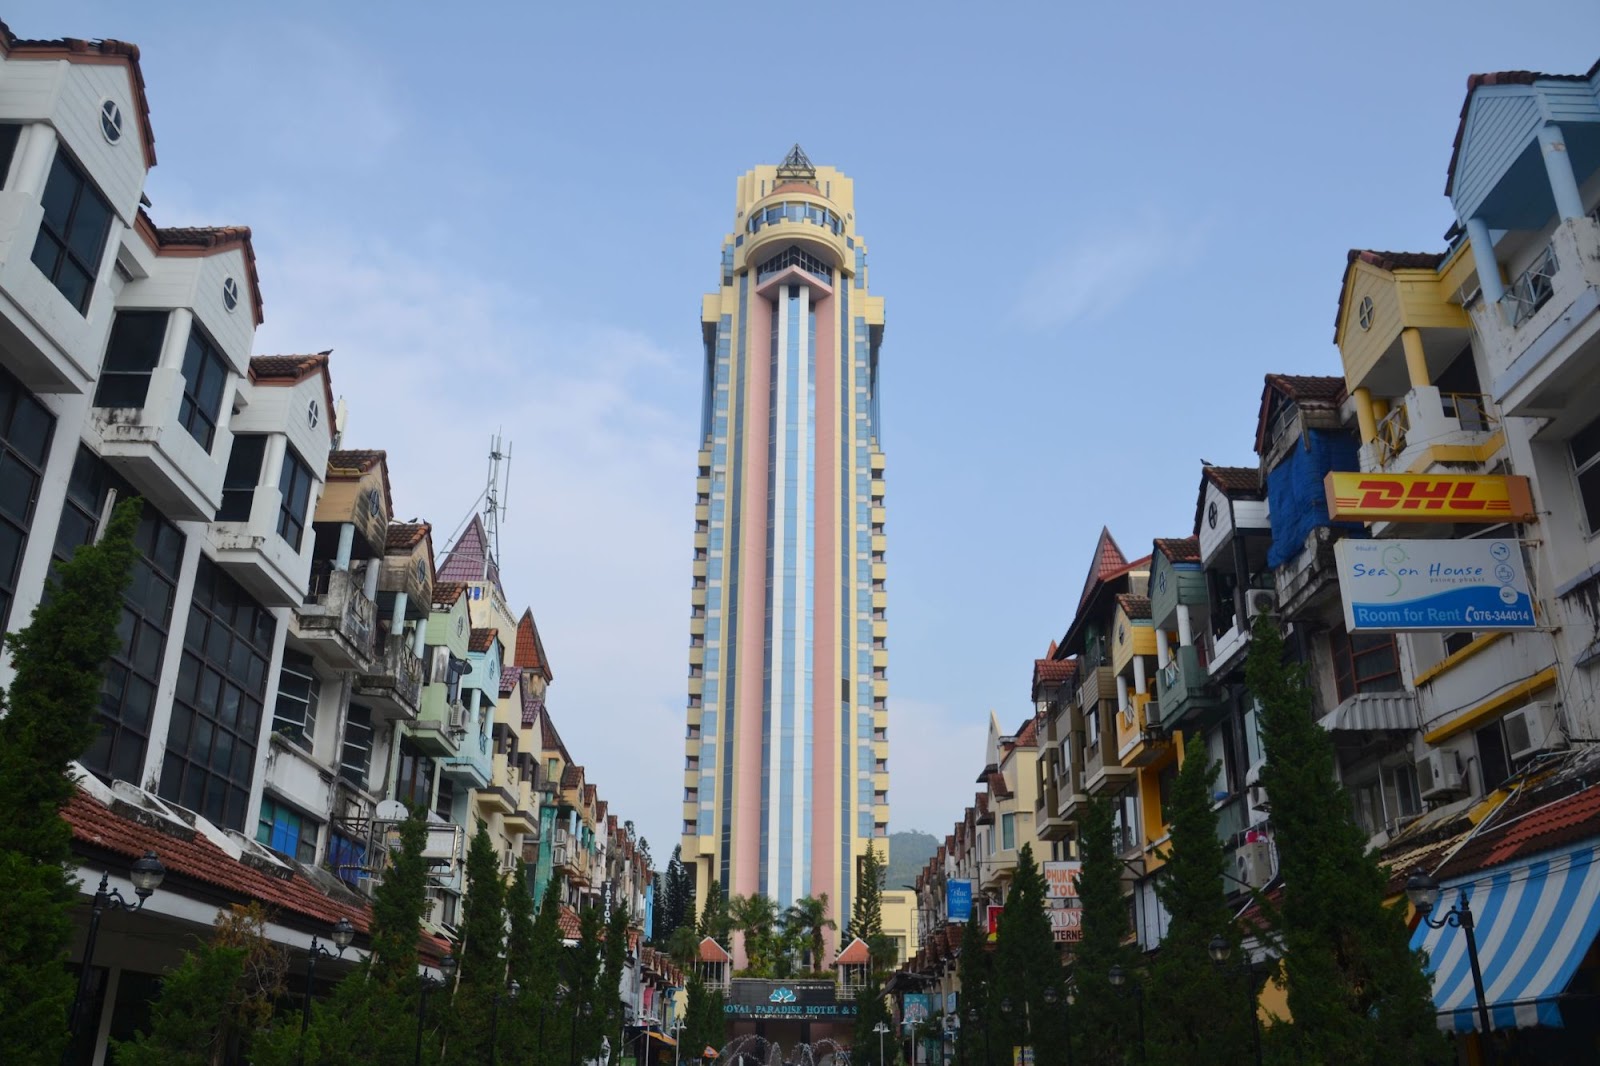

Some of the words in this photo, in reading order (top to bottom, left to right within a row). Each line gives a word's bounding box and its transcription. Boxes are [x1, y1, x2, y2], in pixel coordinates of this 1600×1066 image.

[1357, 480, 1489, 510] DHL
[1429, 562, 1483, 577] House
[1357, 608, 1400, 622] Room
[1403, 608, 1424, 621] for
[1427, 607, 1460, 621] Rent
[1473, 610, 1530, 622] 076-344014
[1052, 884, 1078, 897] TOU
[604, 882, 612, 924] TATTOO
[1053, 930, 1084, 940] TERNE
[755, 1005, 803, 1014] PARADISE
[806, 1005, 839, 1015] HOTEL
[841, 1006, 850, 1015] &
